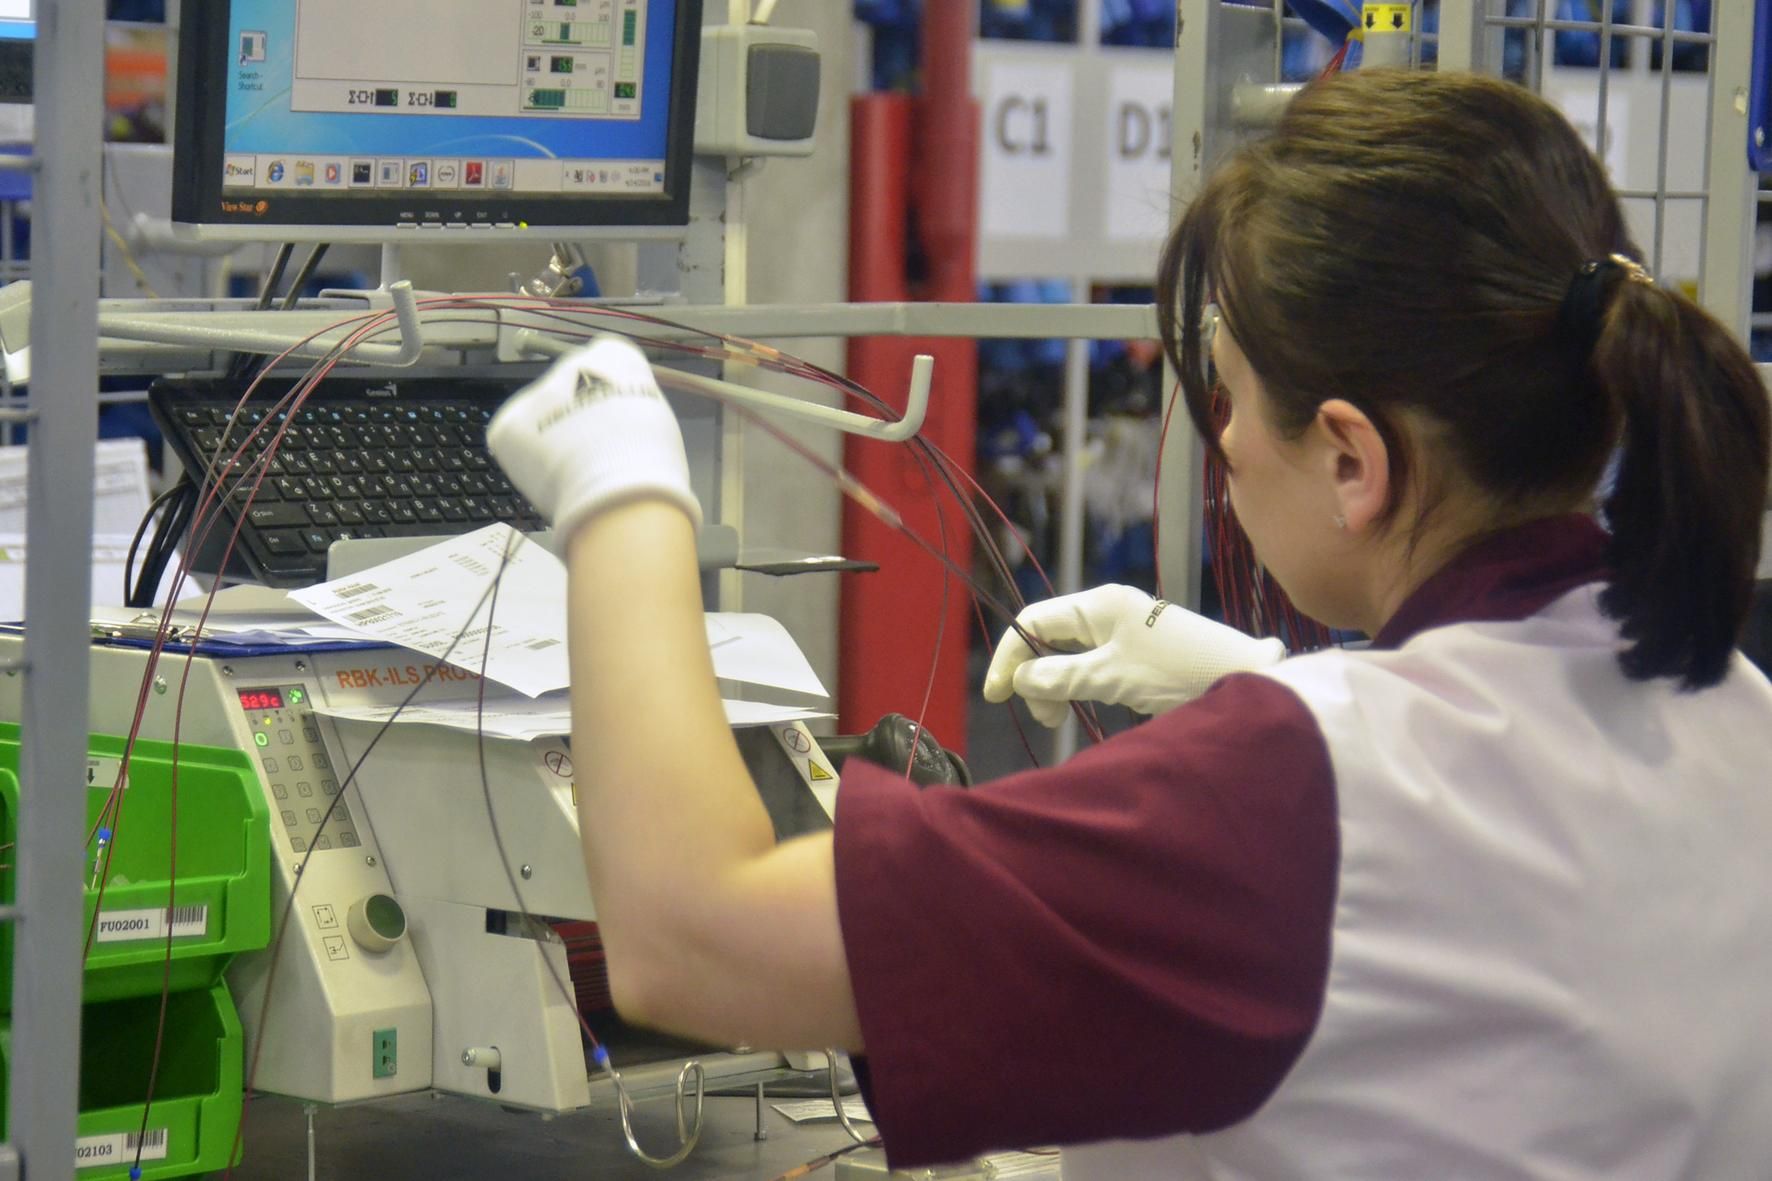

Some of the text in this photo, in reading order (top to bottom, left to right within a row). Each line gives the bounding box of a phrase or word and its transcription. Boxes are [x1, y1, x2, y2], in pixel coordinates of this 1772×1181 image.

[996, 96, 1050, 154] C1
[1120, 102, 1171, 159] D1
[235, 164, 254, 177] Start
[1145, 601, 1168, 628] DEL
[337, 665, 420, 689] RBK-ILS
[100, 919, 150, 933] FU02001
[76, 1144, 112, 1158] 02103
